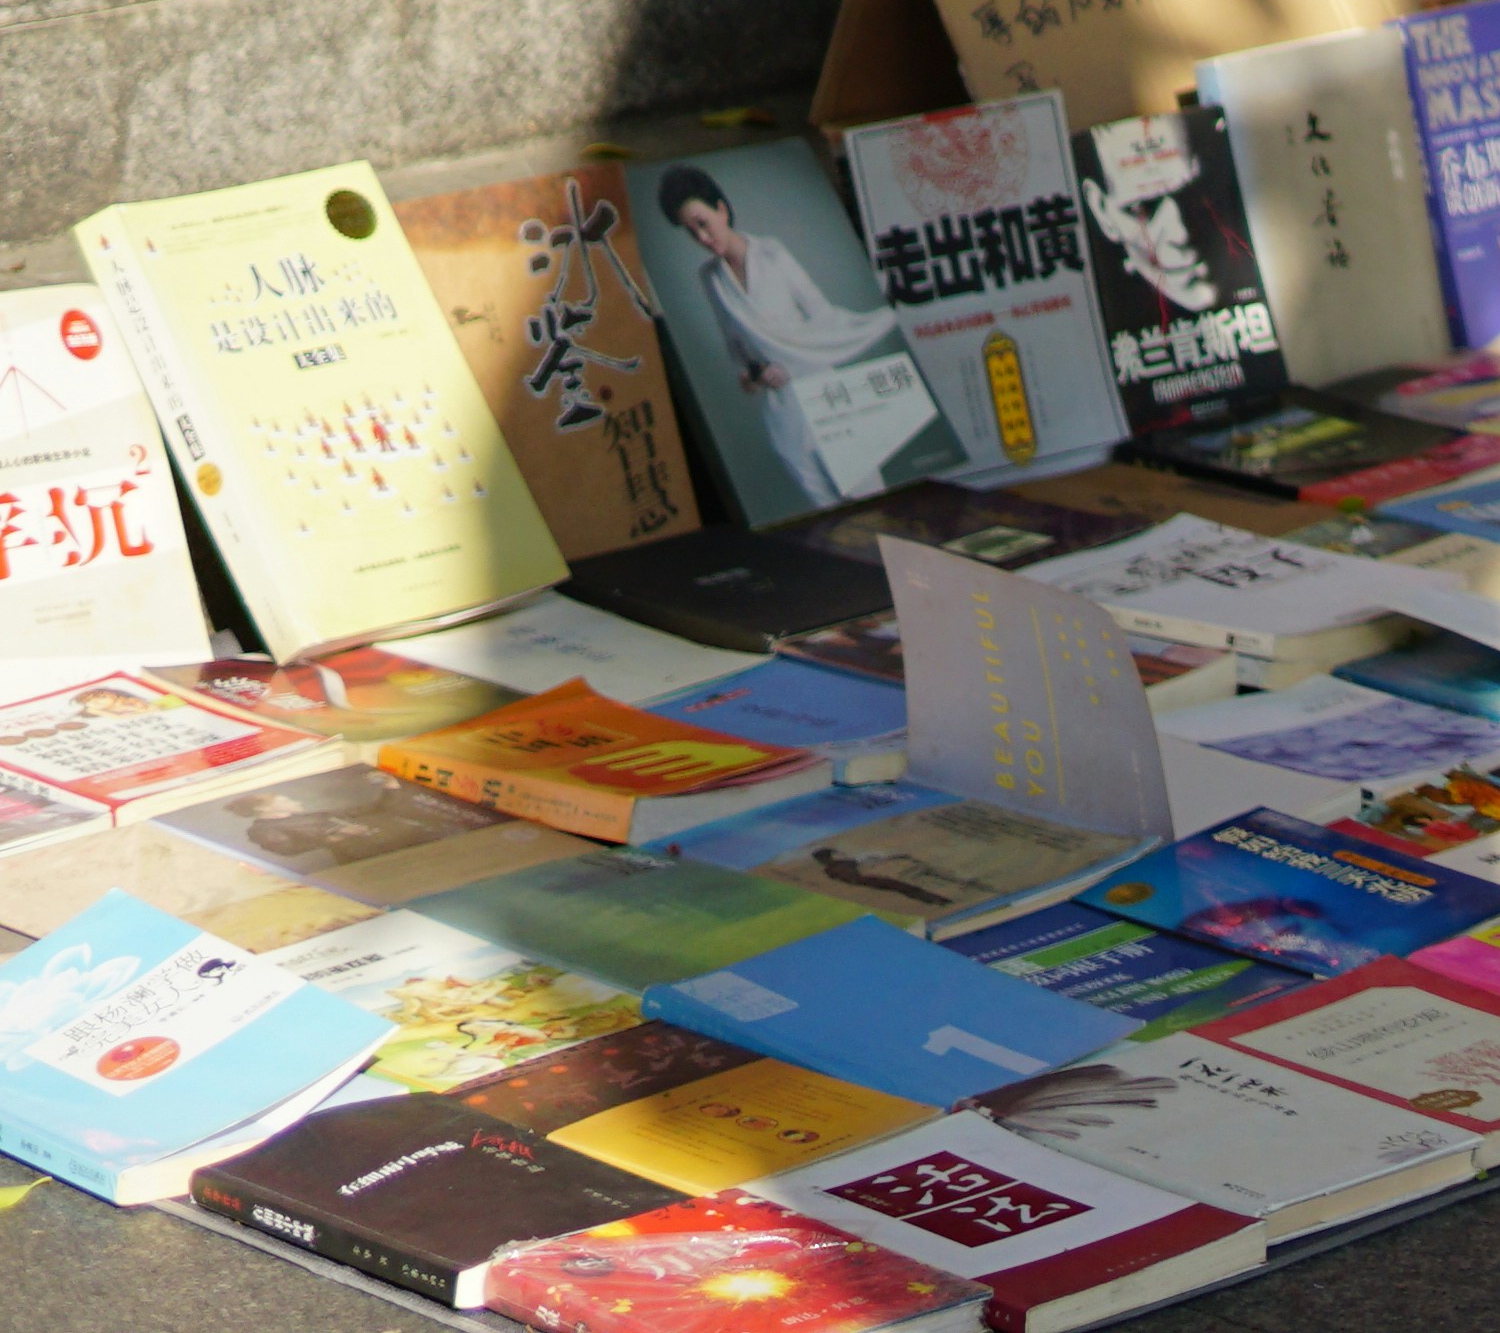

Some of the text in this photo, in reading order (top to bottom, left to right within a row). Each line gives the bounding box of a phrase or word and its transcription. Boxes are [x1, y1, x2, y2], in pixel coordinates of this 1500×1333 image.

[1409, 14, 1471, 60] THE
[250, 253, 325, 301] 人脉
[873, 194, 1085, 309] 走出和黄
[210, 289, 399, 353] 是设计出来的
[519, 177, 658, 430] 冰鉴
[1110, 302, 1280, 385] 弗兰肯斯坦
[129, 443, 151, 475] 2
[971, 590, 1015, 791] BEAUTIFUL
[1020, 719, 1046, 797] YOU
[63, 948, 208, 1042] 跟杨澜学做
[867, 1162, 1070, 1234] 活法
